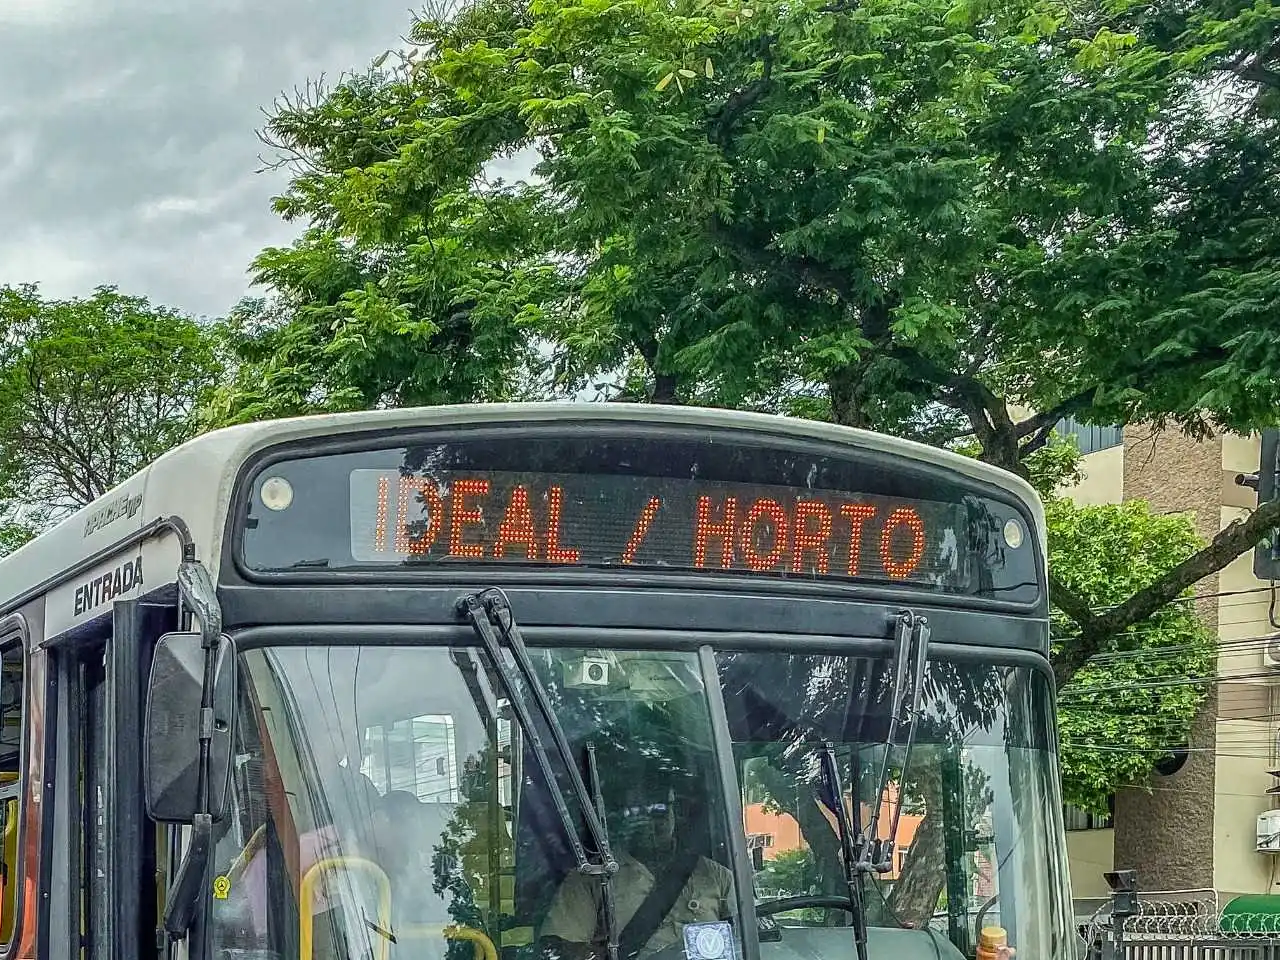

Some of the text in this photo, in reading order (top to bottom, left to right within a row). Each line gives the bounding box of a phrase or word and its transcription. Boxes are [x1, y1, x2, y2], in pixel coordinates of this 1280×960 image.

[373, 476, 925, 579] IDEAL / HORTO
[73, 555, 144, 617] ENTRADA
